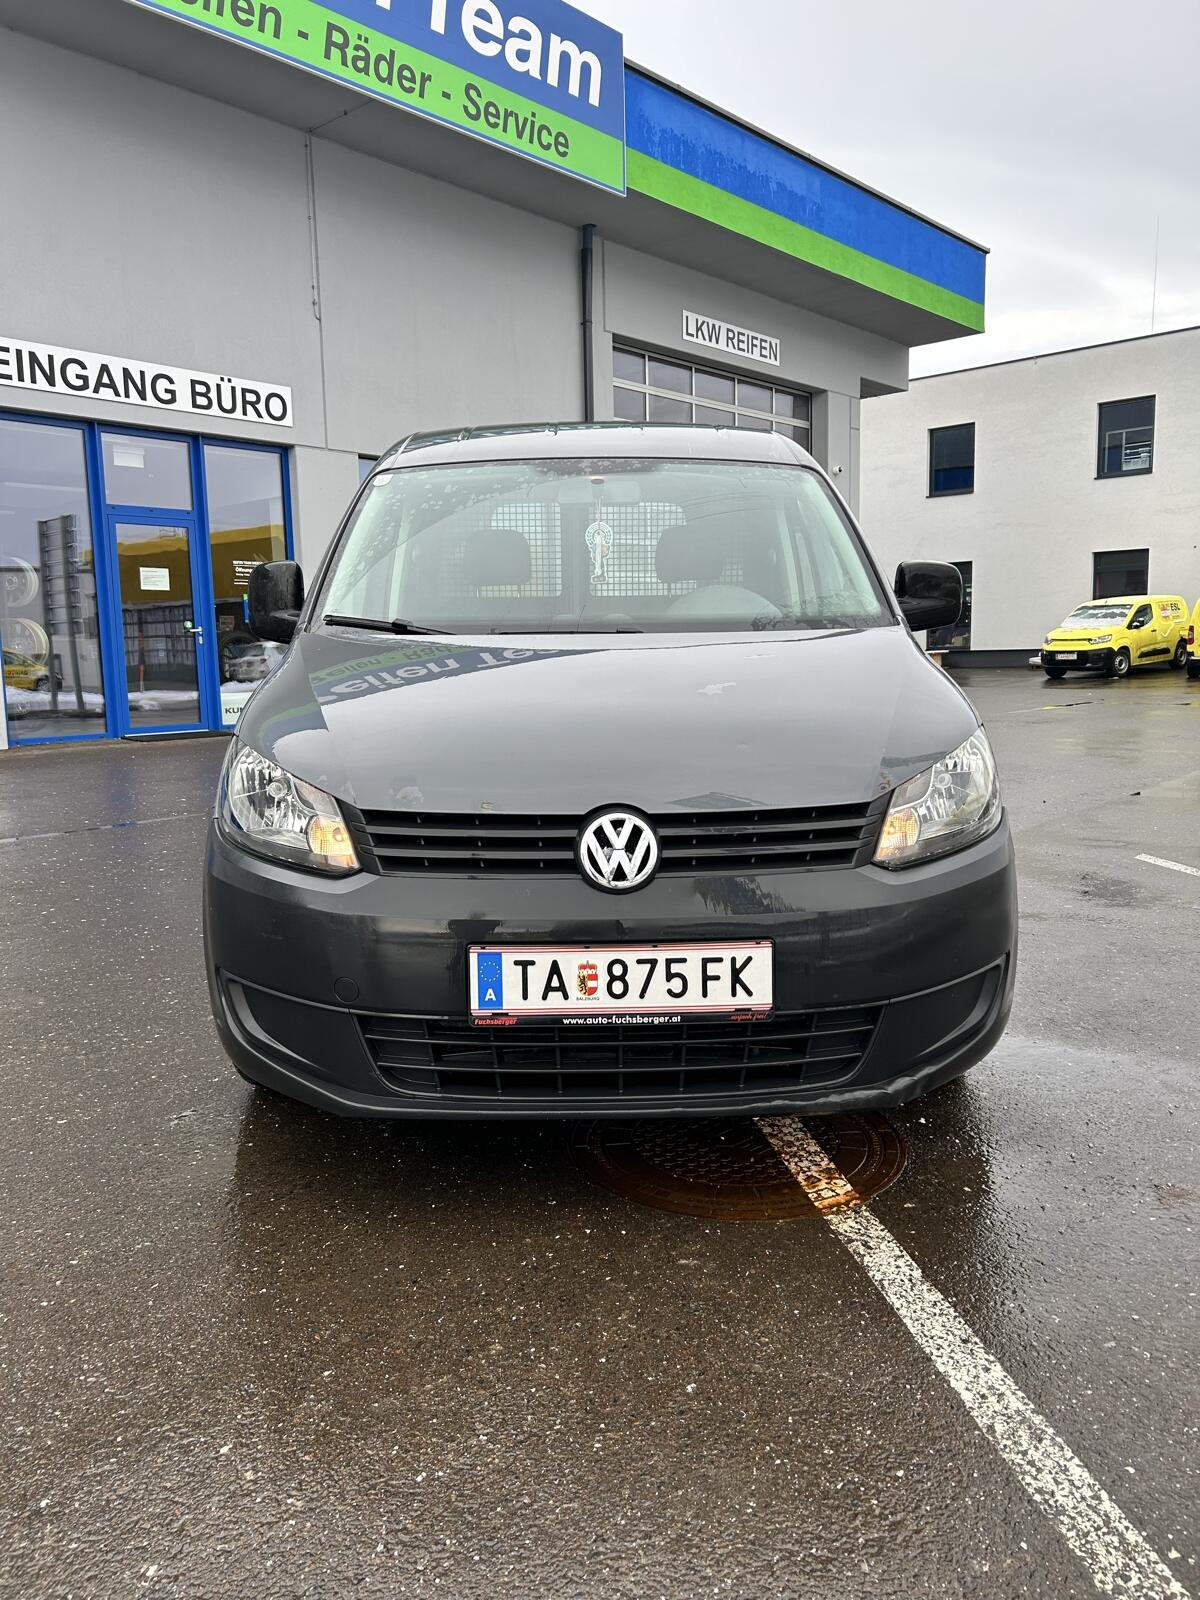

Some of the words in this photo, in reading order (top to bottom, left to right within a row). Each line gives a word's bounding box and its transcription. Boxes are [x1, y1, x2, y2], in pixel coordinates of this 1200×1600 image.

[324, 21, 432, 100] Räder
[462, 82, 570, 158] Service
[685, 315, 722, 345] LKW
[726, 327, 778, 362] REIFEN
[190, 376, 288, 422] BÜRO
[484, 989, 497, 1001] A
[513, 959, 570, 1001] TA
[562, 1014, 682, 1025] www.auto-fuchsberger.at
